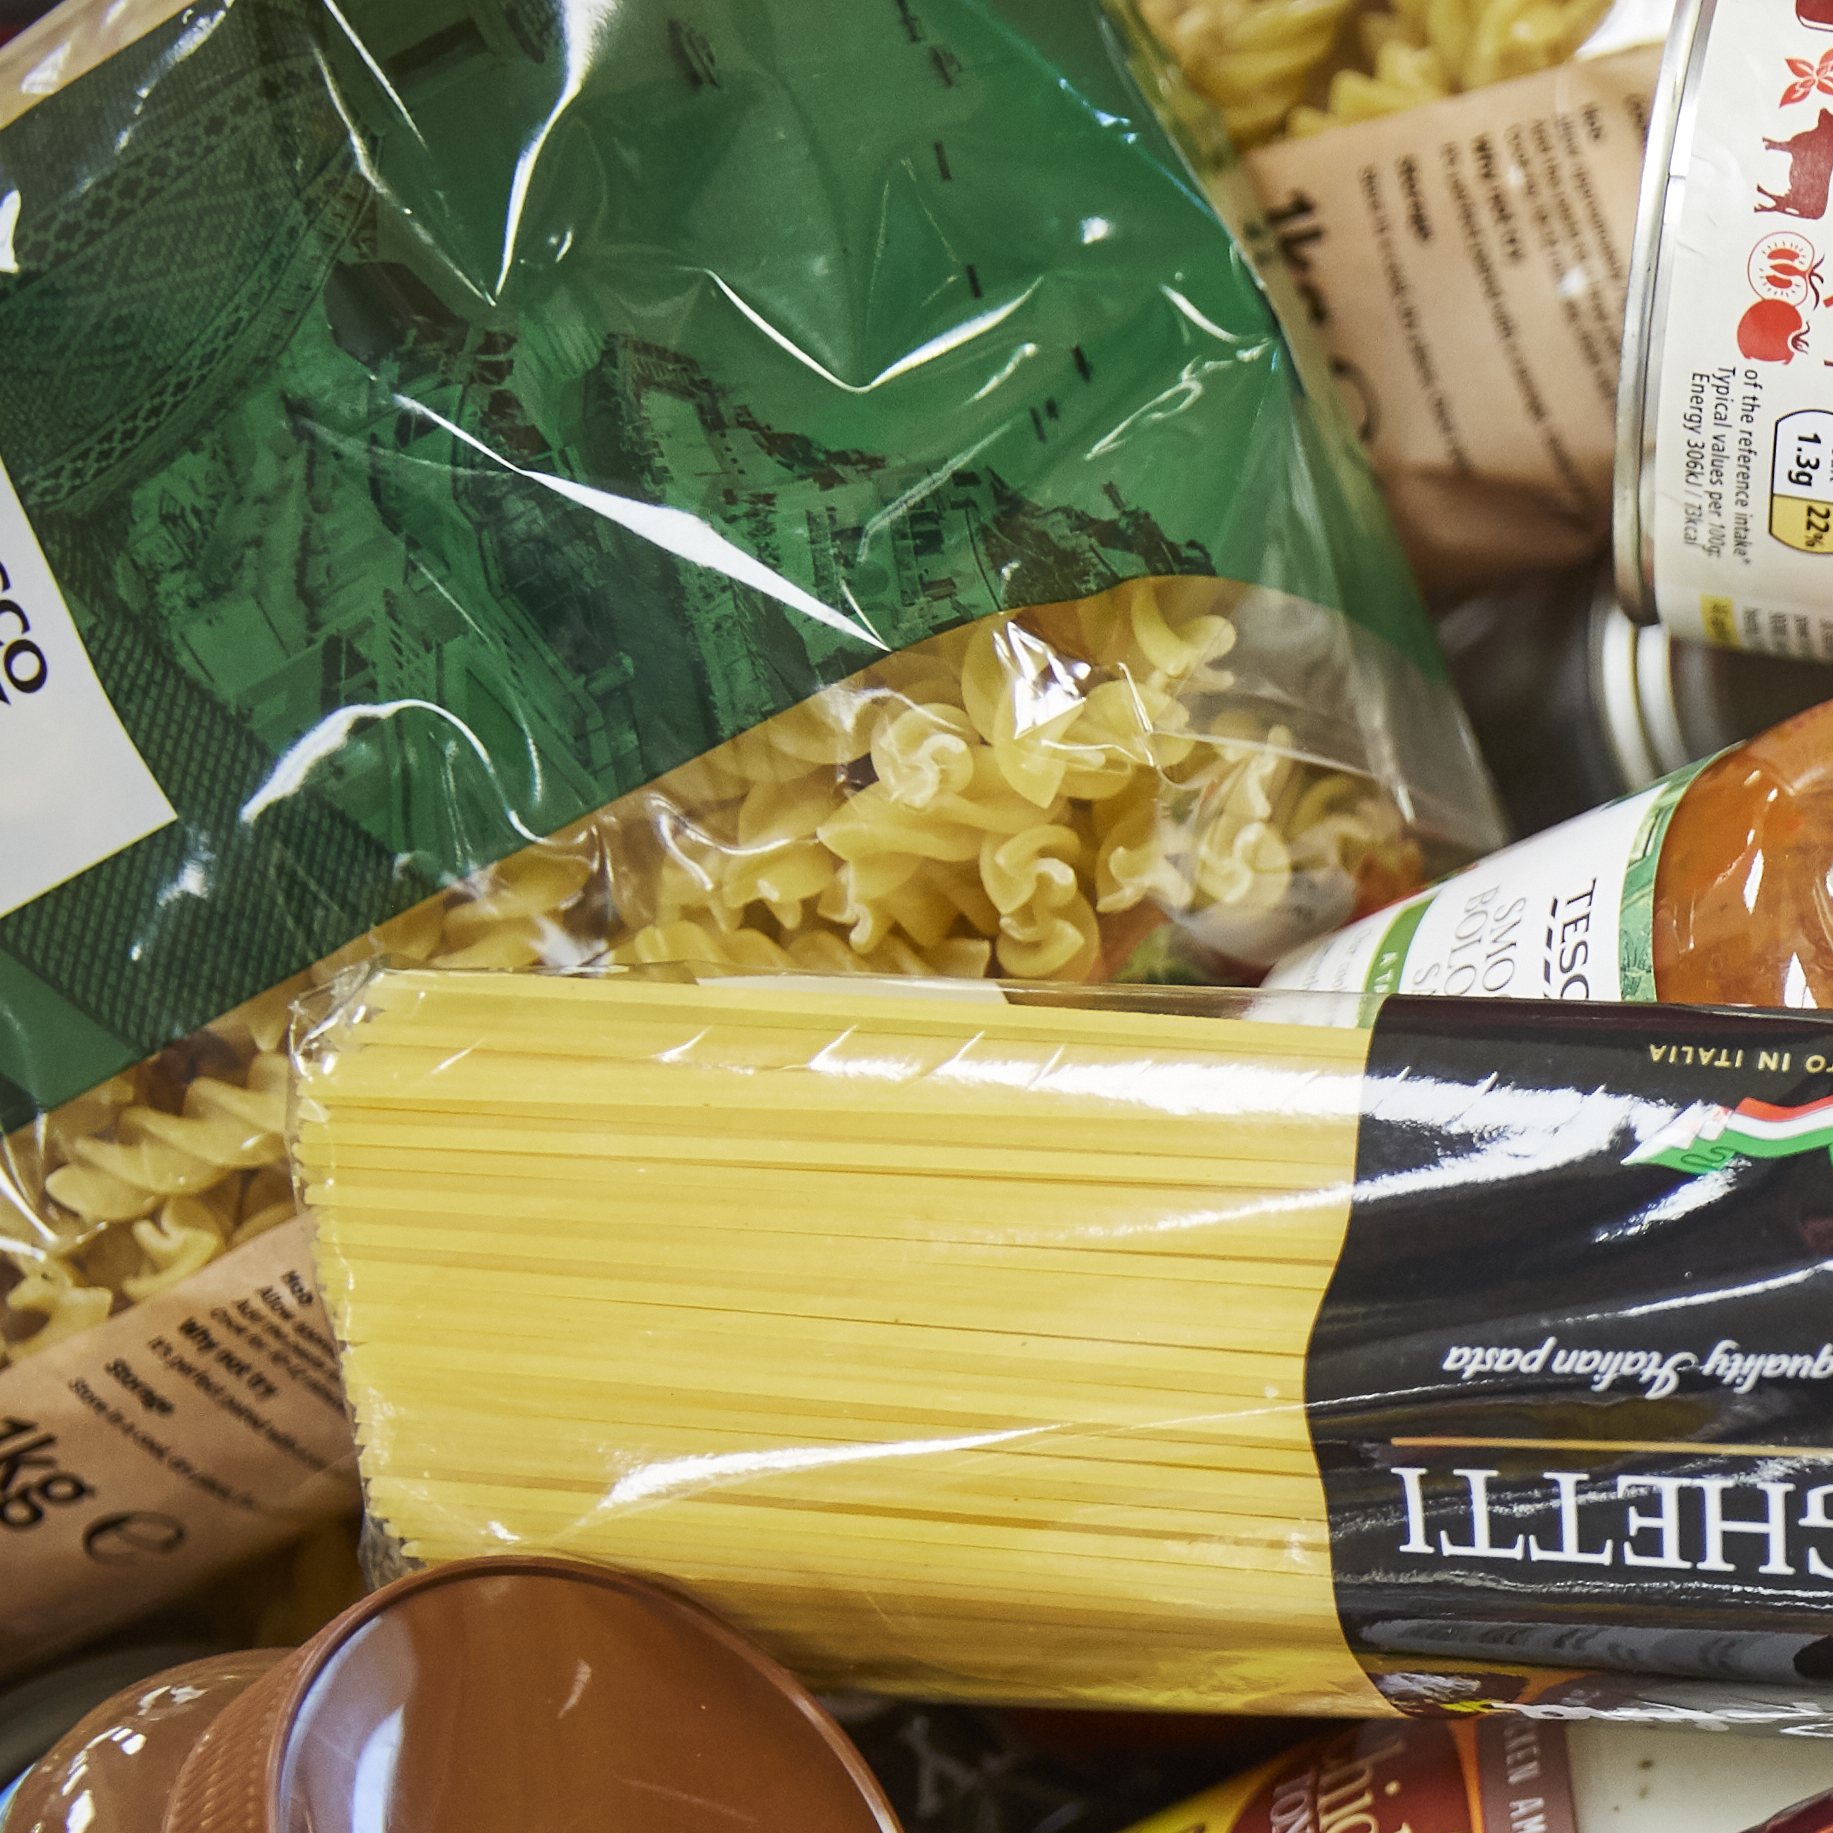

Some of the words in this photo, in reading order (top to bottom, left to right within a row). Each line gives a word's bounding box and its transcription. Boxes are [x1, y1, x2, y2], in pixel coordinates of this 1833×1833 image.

[1683, 373, 1710, 436] Energy
[1713, 366, 1736, 428] Typical
[1744, 369, 1763, 391] of
[1740, 394, 1761, 424] the
[1708, 431, 1729, 486] values
[1736, 430, 1759, 506] reference
[1788, 432, 1821, 487] 1.3g
[1708, 490, 1723, 519] per
[1804, 505, 1831, 549] 22%
[1487, 896, 1526, 1000] SMO
[1555, 877, 1600, 1001] TESC
[1649, 1042, 1741, 1074] ITALIA
[1755, 1047, 1790, 1075] IN
[1440, 1335, 1555, 1376] pasta
[1553, 1335, 1698, 1399] Italian
